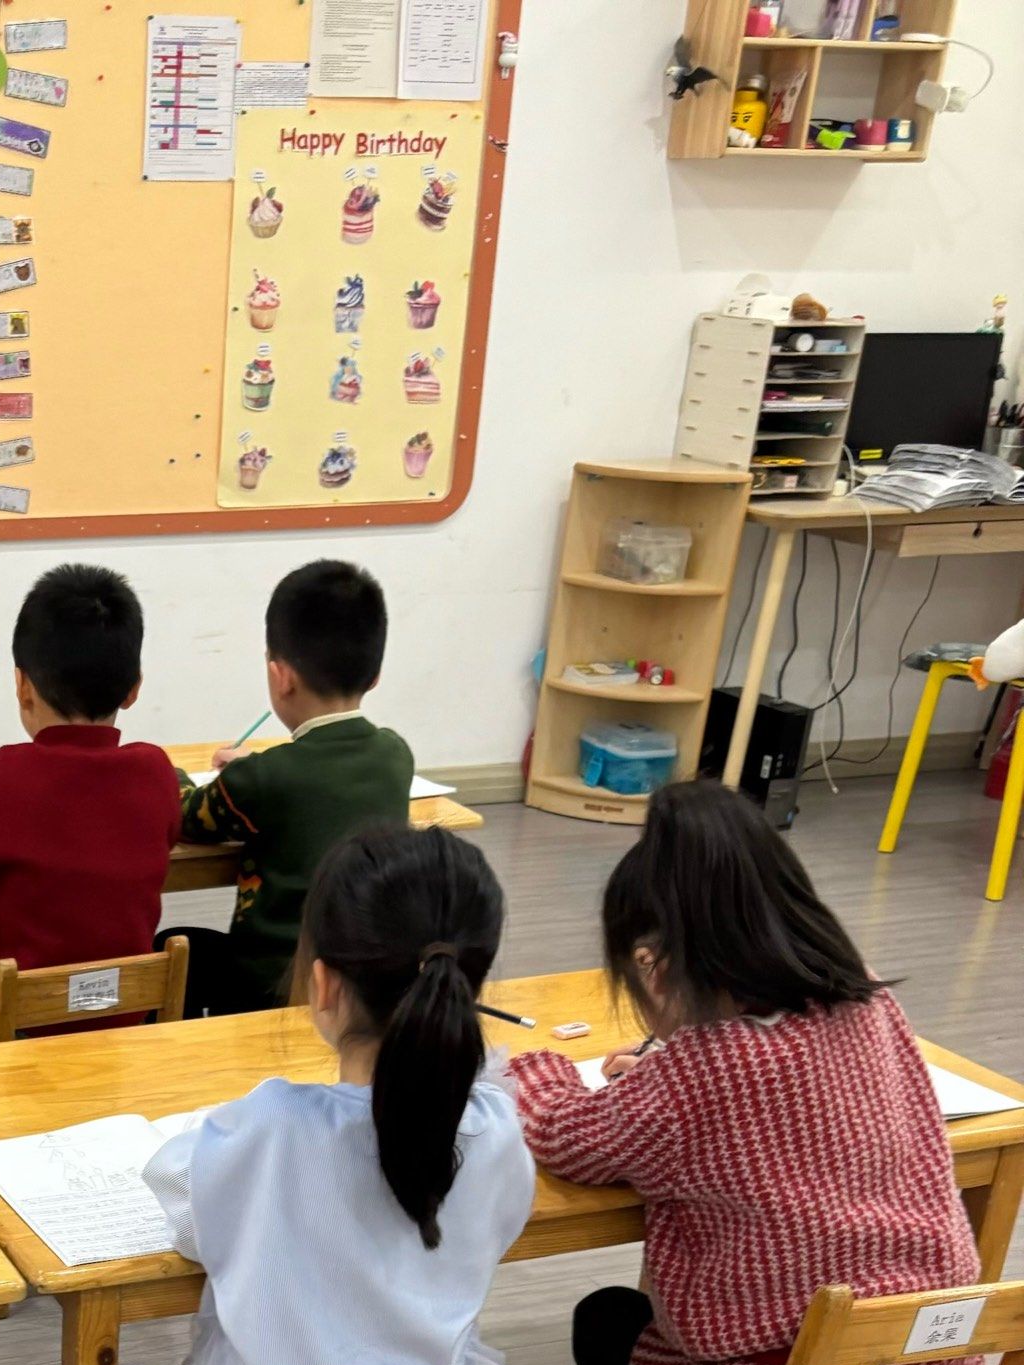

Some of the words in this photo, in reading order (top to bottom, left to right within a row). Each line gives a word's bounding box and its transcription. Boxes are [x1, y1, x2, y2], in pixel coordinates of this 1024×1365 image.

[280, 127, 345, 156] Happy
[356, 130, 447, 159] Birthday
[930, 1312, 965, 1326] Aria
